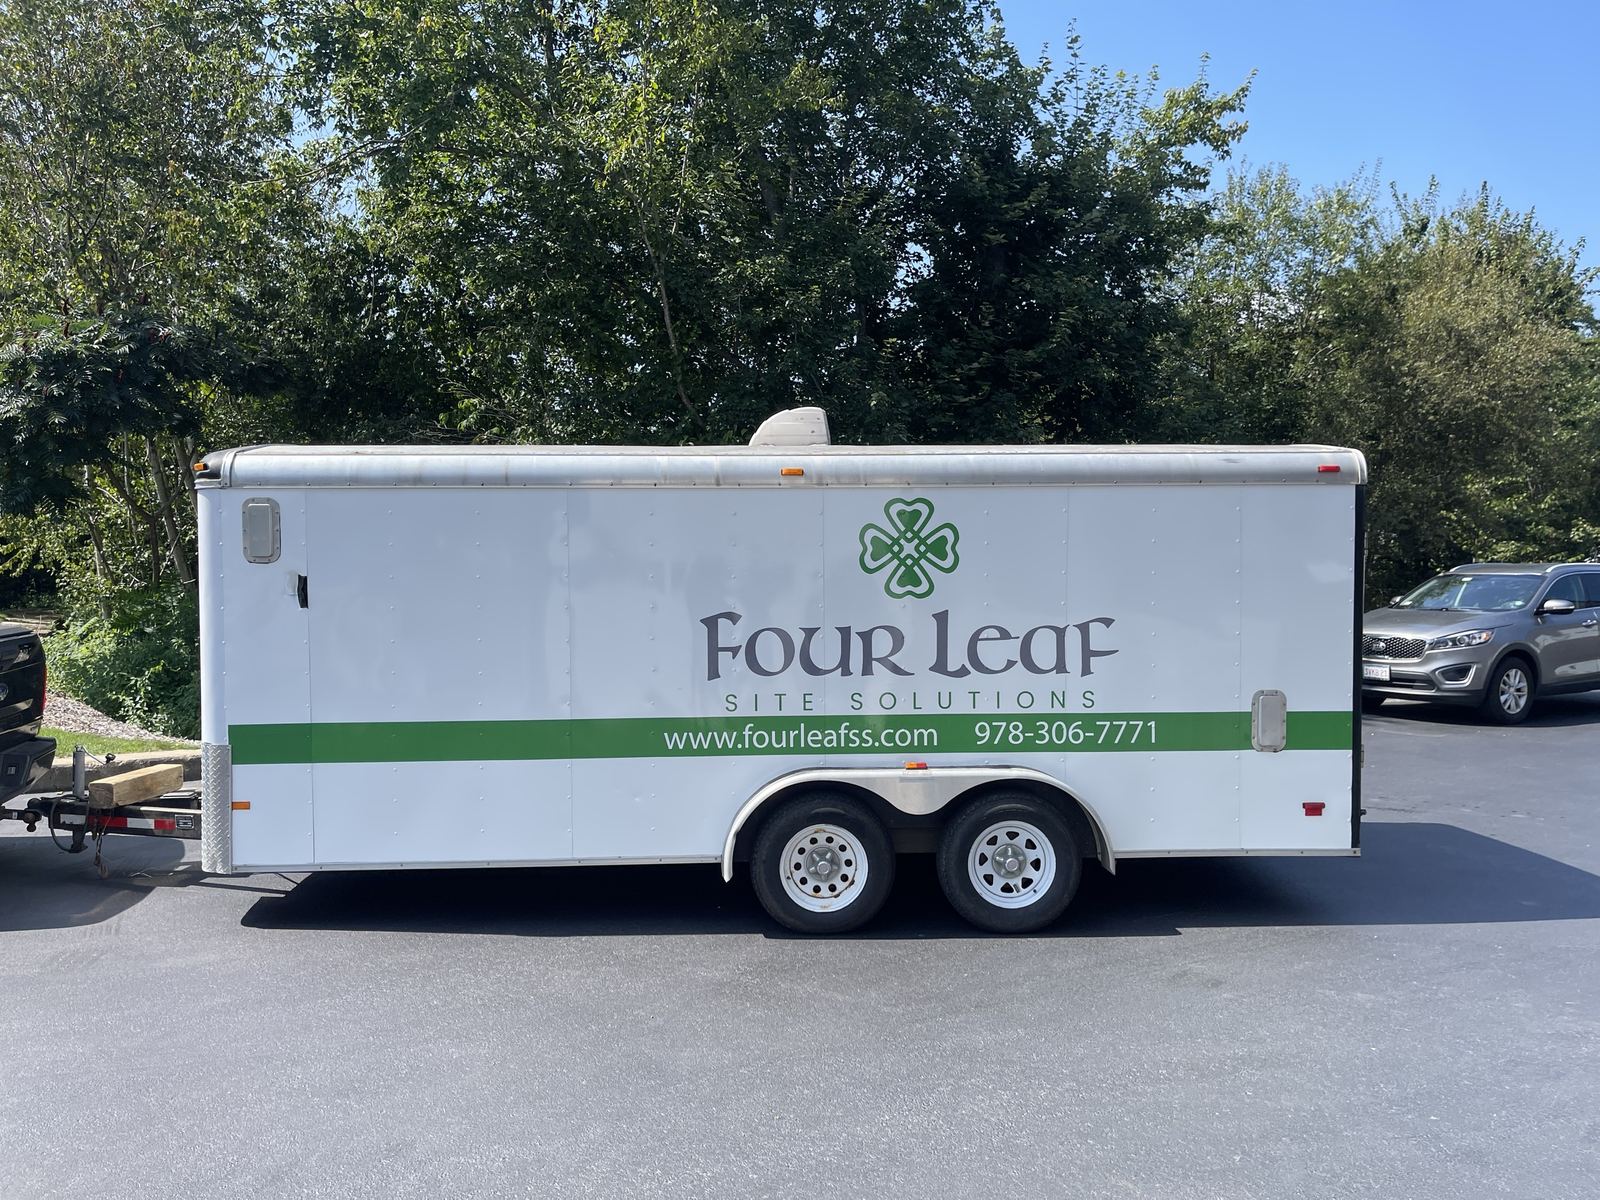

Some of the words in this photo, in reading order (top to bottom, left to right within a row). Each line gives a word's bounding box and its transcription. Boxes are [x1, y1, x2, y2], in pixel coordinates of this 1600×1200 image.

[725, 692, 814, 712] SITE
[851, 690, 1096, 710] SOLUTIONS
[664, 723, 938, 750] www.fourleafss.com
[974, 720, 1156, 745] 978-306-7771
